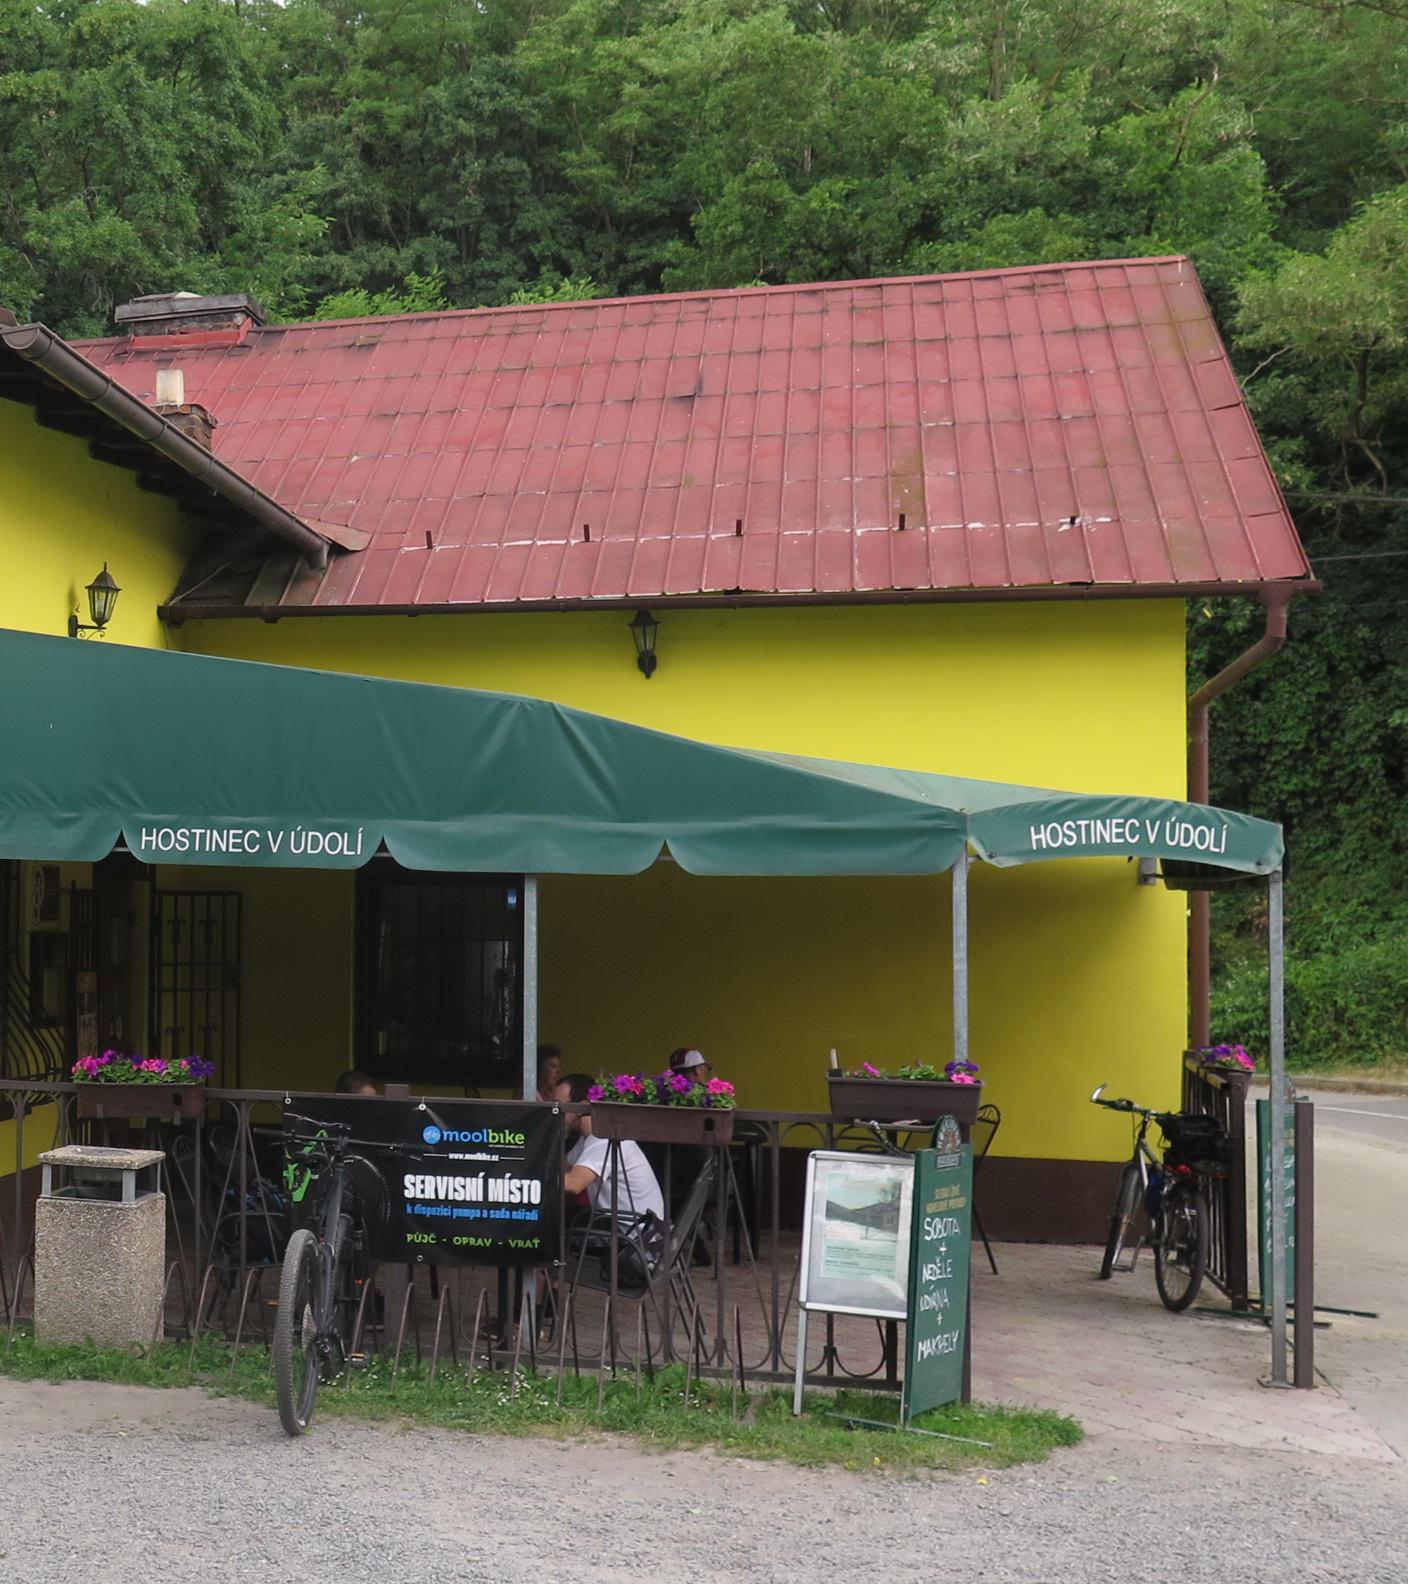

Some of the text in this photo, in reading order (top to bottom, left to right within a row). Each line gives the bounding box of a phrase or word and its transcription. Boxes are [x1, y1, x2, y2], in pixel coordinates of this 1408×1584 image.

[141, 826, 364, 856] HOSTINEC V ÚDOLÍ
[1030, 816, 1228, 854] HOSTINEC V ÚDOLÍ
[442, 1128, 526, 1145] moolbike
[403, 1172, 542, 1205] SERVISNÍ MÍSTO
[406, 1204, 413, 1214] k
[414, 1204, 452, 1217] dispozici
[453, 1207, 481, 1220] pumpa
[482, 1210, 488, 1218] a
[489, 1208, 511, 1219] sada
[453, 1236, 493, 1247] OPRAV
[508, 1238, 541, 1249] VRAŤ
[923, 1217, 961, 1241] SOBOTA
[922, 1256, 953, 1283] NEDĚLE
[917, 1329, 960, 1362] MAKRELY
